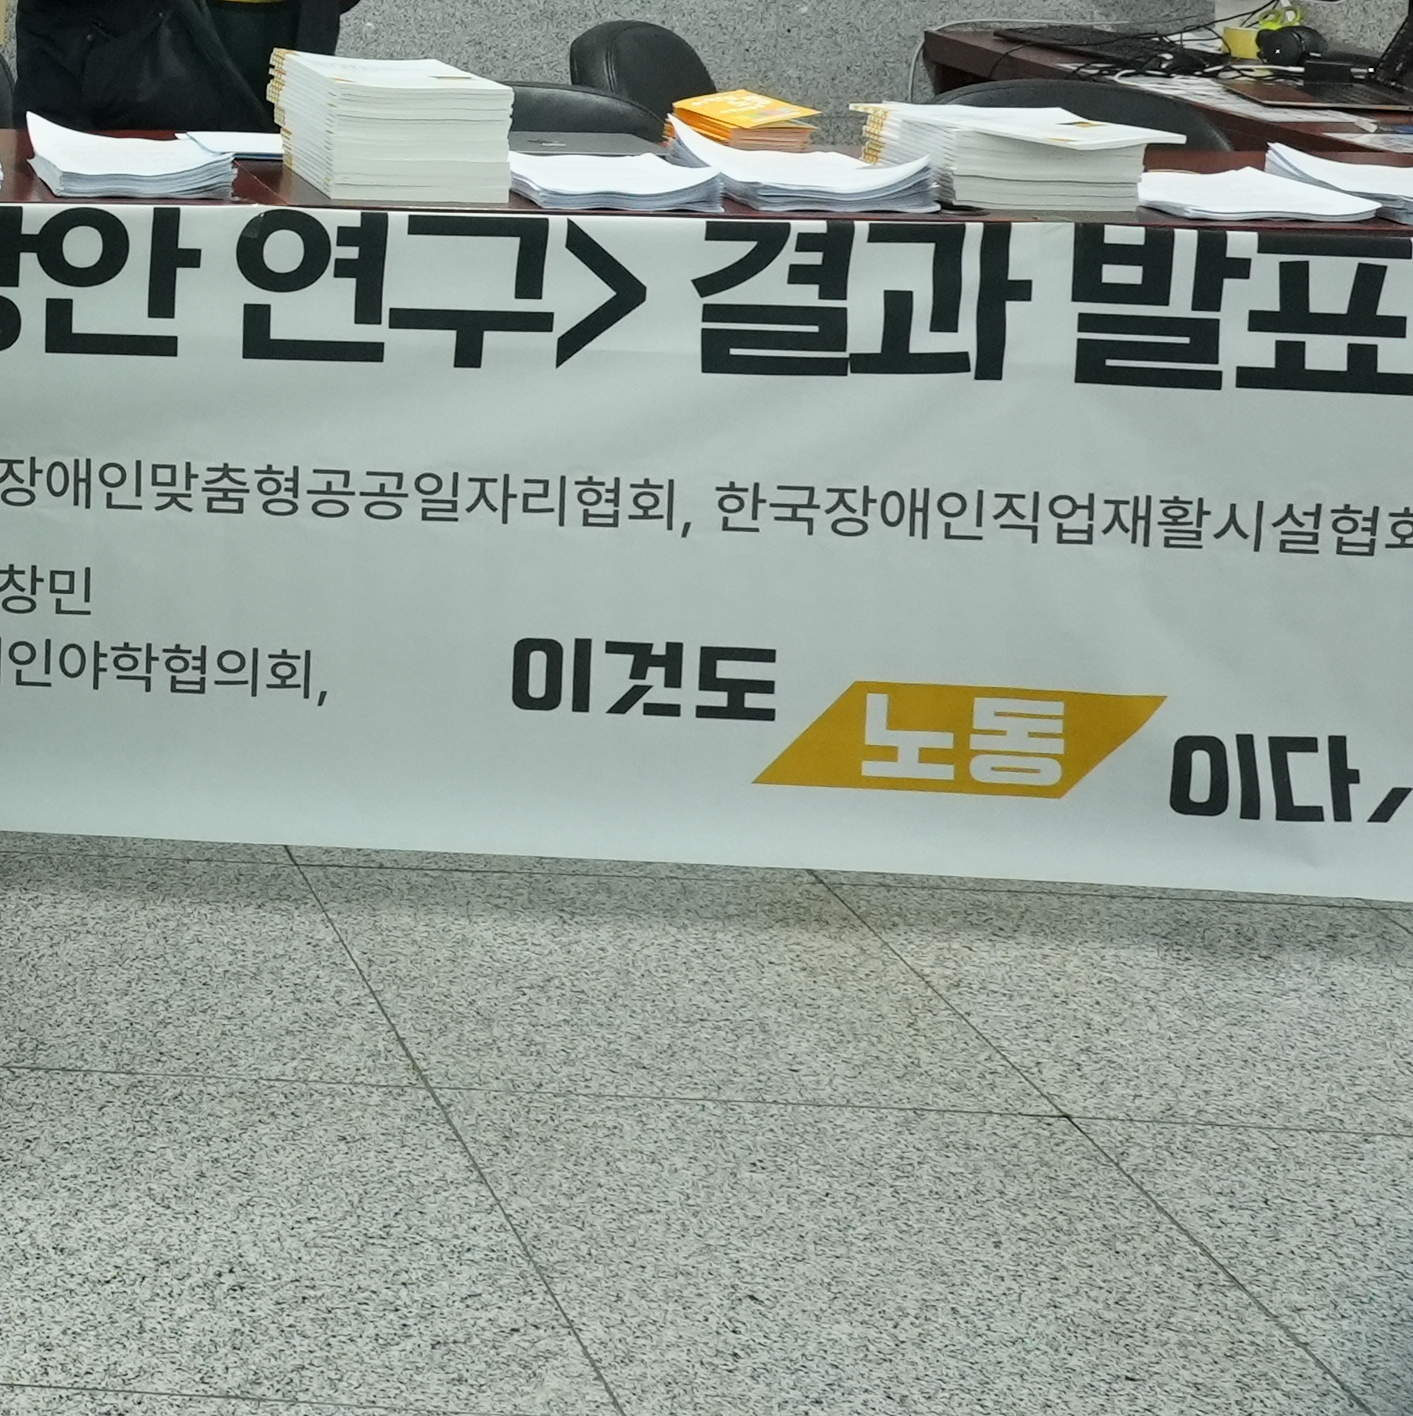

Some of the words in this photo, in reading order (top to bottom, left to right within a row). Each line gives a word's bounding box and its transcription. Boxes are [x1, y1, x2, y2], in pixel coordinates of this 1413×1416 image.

[235, 209, 647, 369] 연구>
[691, 221, 1032, 380] 결과
[1072, 224, 1413, 396] 발표
[512, 638, 776, 721] 이것도
[861, 693, 1064, 786] 노동
